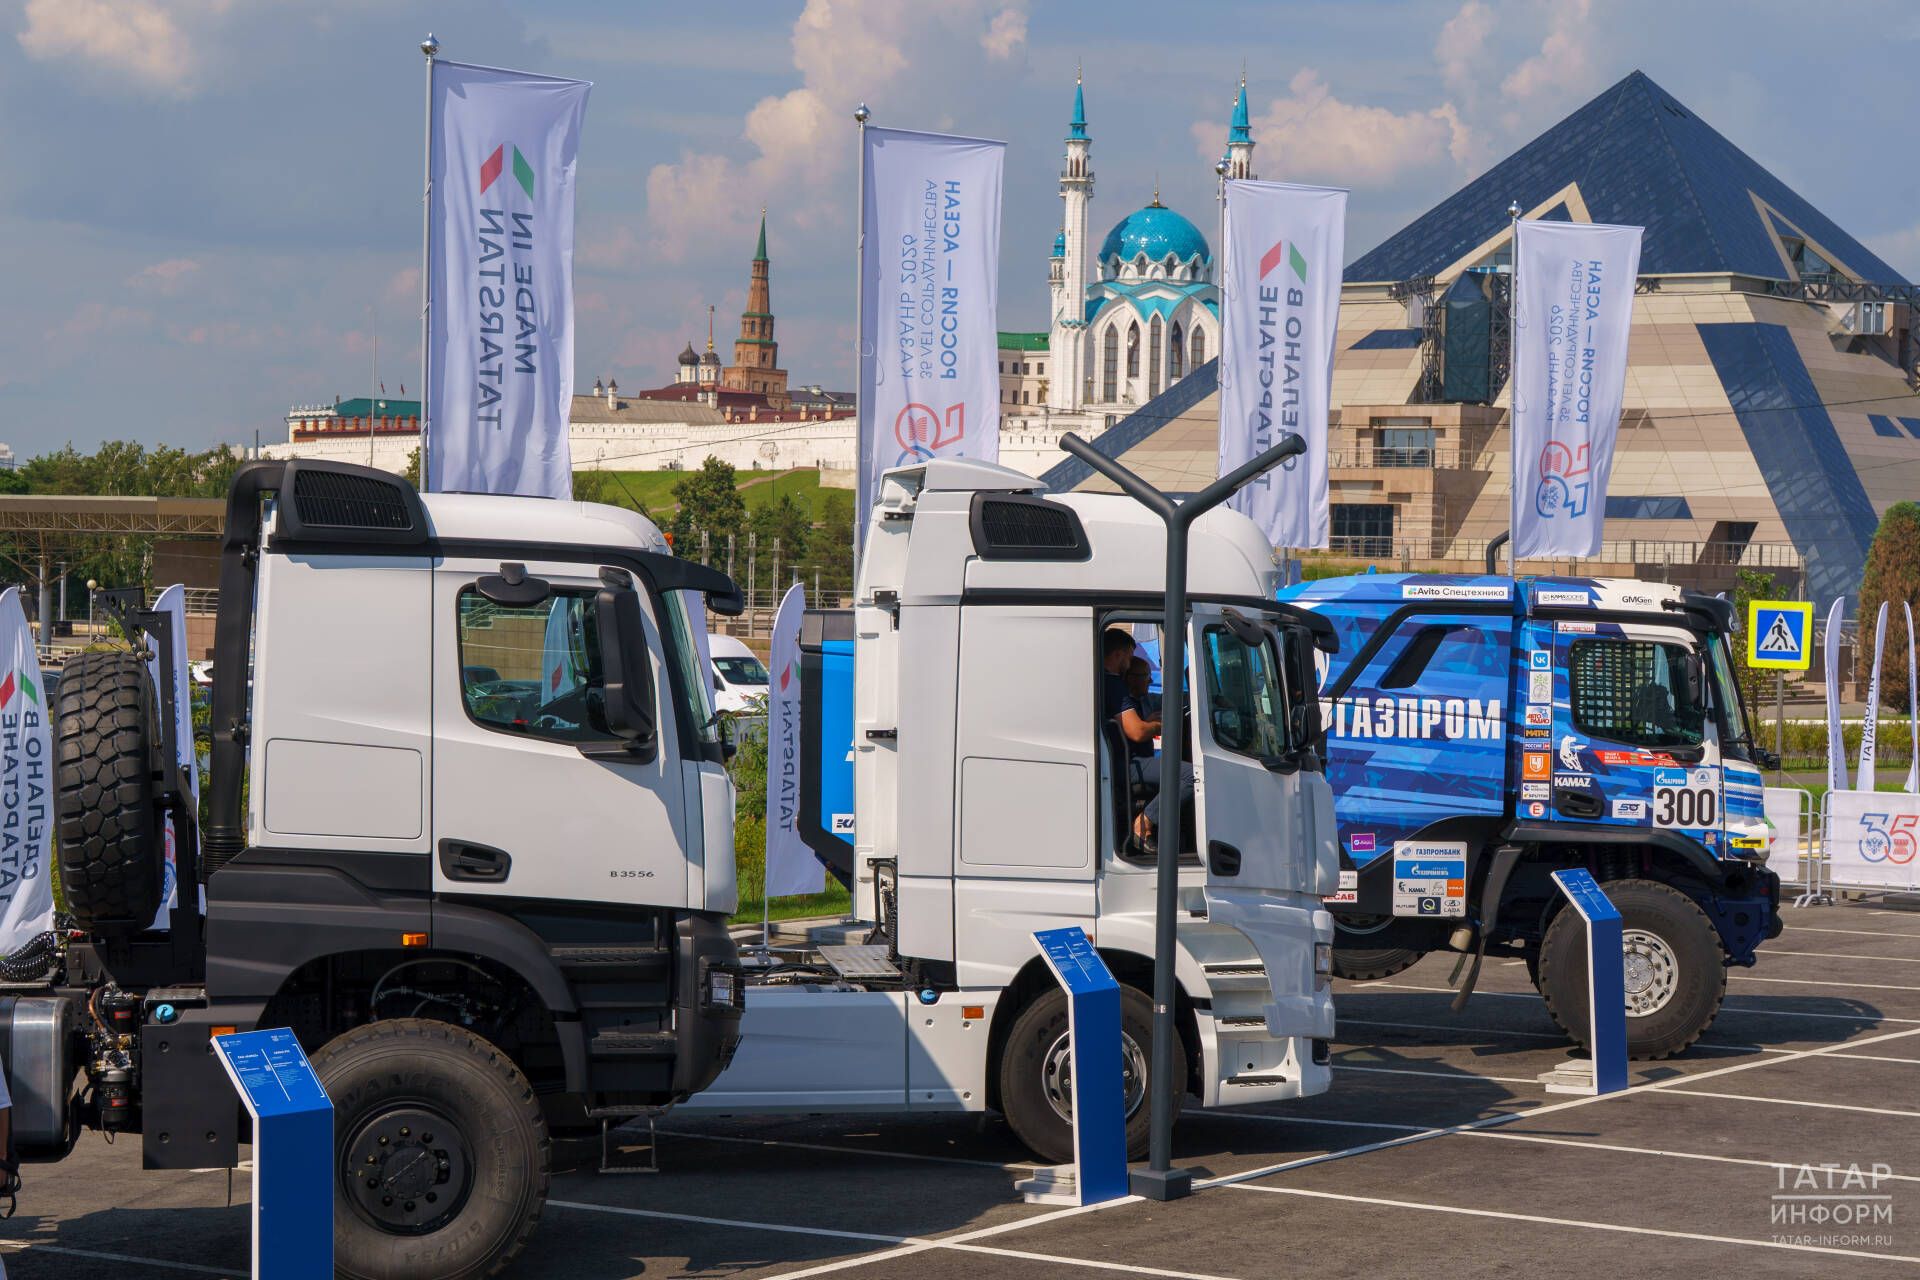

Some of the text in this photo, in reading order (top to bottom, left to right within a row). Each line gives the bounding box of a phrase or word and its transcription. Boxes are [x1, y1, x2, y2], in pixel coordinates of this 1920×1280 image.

[1442, 588, 1505, 597] Спецтехника
[1336, 698, 1501, 740] ГАЗПРОМ
[1555, 777, 1591, 787] KAMAZ
[1656, 788, 1715, 826] 300
[1415, 848, 1461, 856] ГАЗПРОМБАНК
